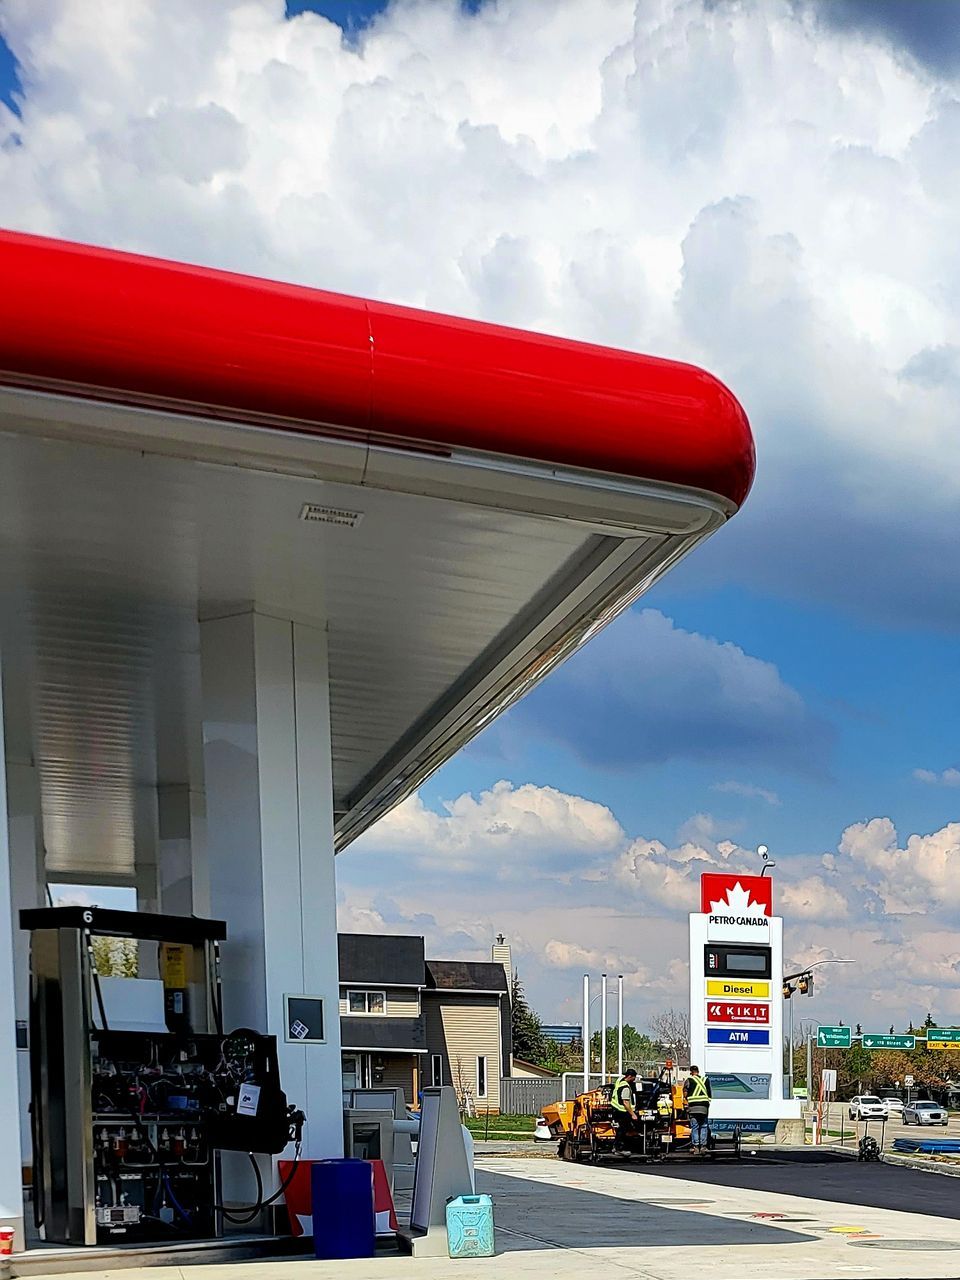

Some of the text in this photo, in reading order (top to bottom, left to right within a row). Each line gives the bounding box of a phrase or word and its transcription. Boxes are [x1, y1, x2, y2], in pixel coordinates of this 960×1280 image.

[83, 910, 93, 923] 6
[723, 985, 753, 994] Diesel
[726, 1006, 767, 1016] KIKIT
[729, 1032, 749, 1042] ATM
